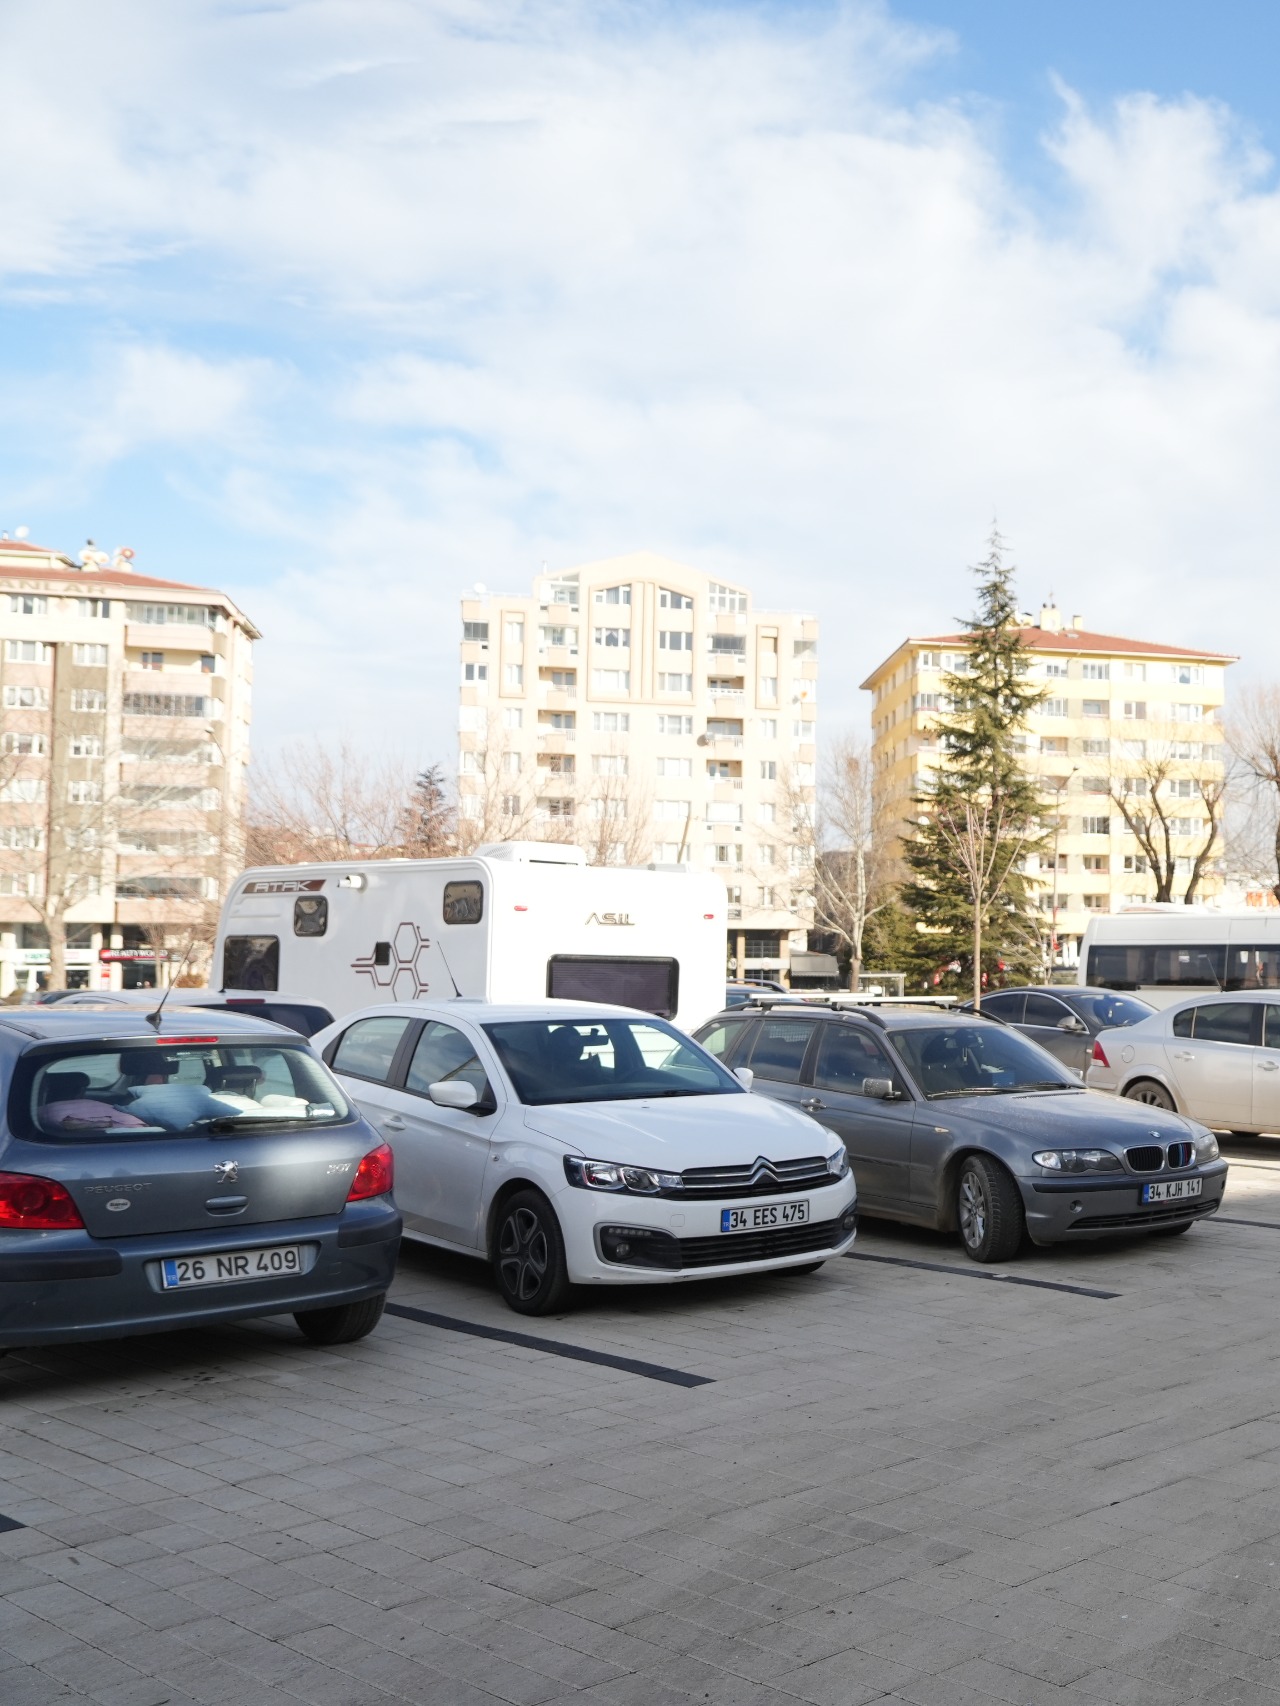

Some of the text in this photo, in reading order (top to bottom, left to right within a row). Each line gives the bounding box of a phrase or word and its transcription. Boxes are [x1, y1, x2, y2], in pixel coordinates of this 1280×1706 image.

[253, 880, 313, 893] ATAK
[84, 1182, 152, 1194] PEUGEOT
[1149, 1180, 1200, 1200] 34 KJH 141
[730, 1210, 747, 1228] 34
[753, 1207, 777, 1226] EES
[782, 1203, 805, 1222] 475
[177, 1260, 206, 1282] 26
[216, 1255, 250, 1278] NR
[256, 1249, 297, 1272] 409
